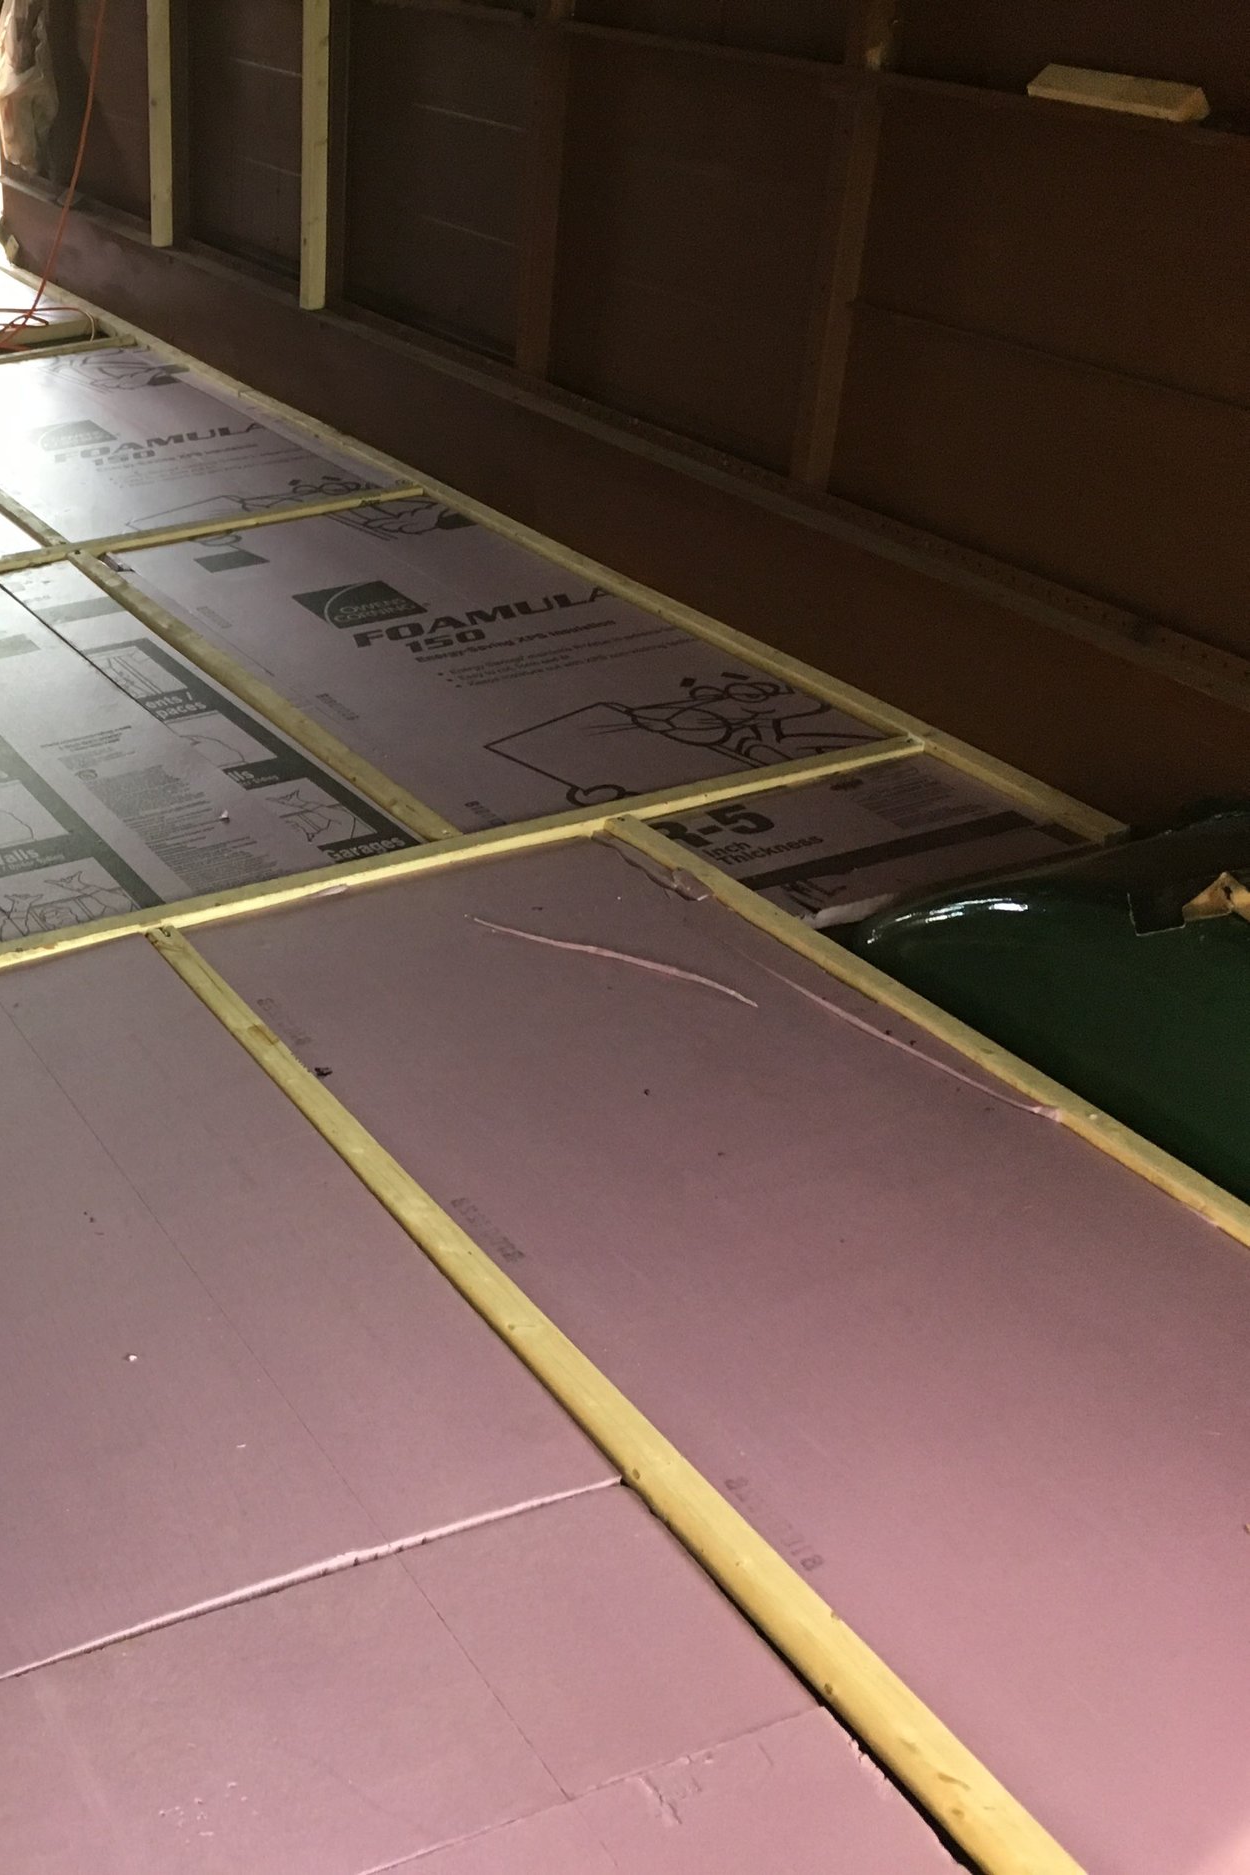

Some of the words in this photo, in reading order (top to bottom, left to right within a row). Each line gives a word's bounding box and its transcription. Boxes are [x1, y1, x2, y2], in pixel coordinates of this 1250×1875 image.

[95, 449, 155, 466] 150
[353, 586, 610, 648] FOAMULA
[406, 628, 485, 653] 150
[146, 694, 183, 709] ents
[155, 701, 207, 720] paces
[649, 804, 774, 848] R-5
[323, 837, 406, 862] Garages
[702, 842, 752, 859] Inch
[716, 836, 824, 865] Thickness
